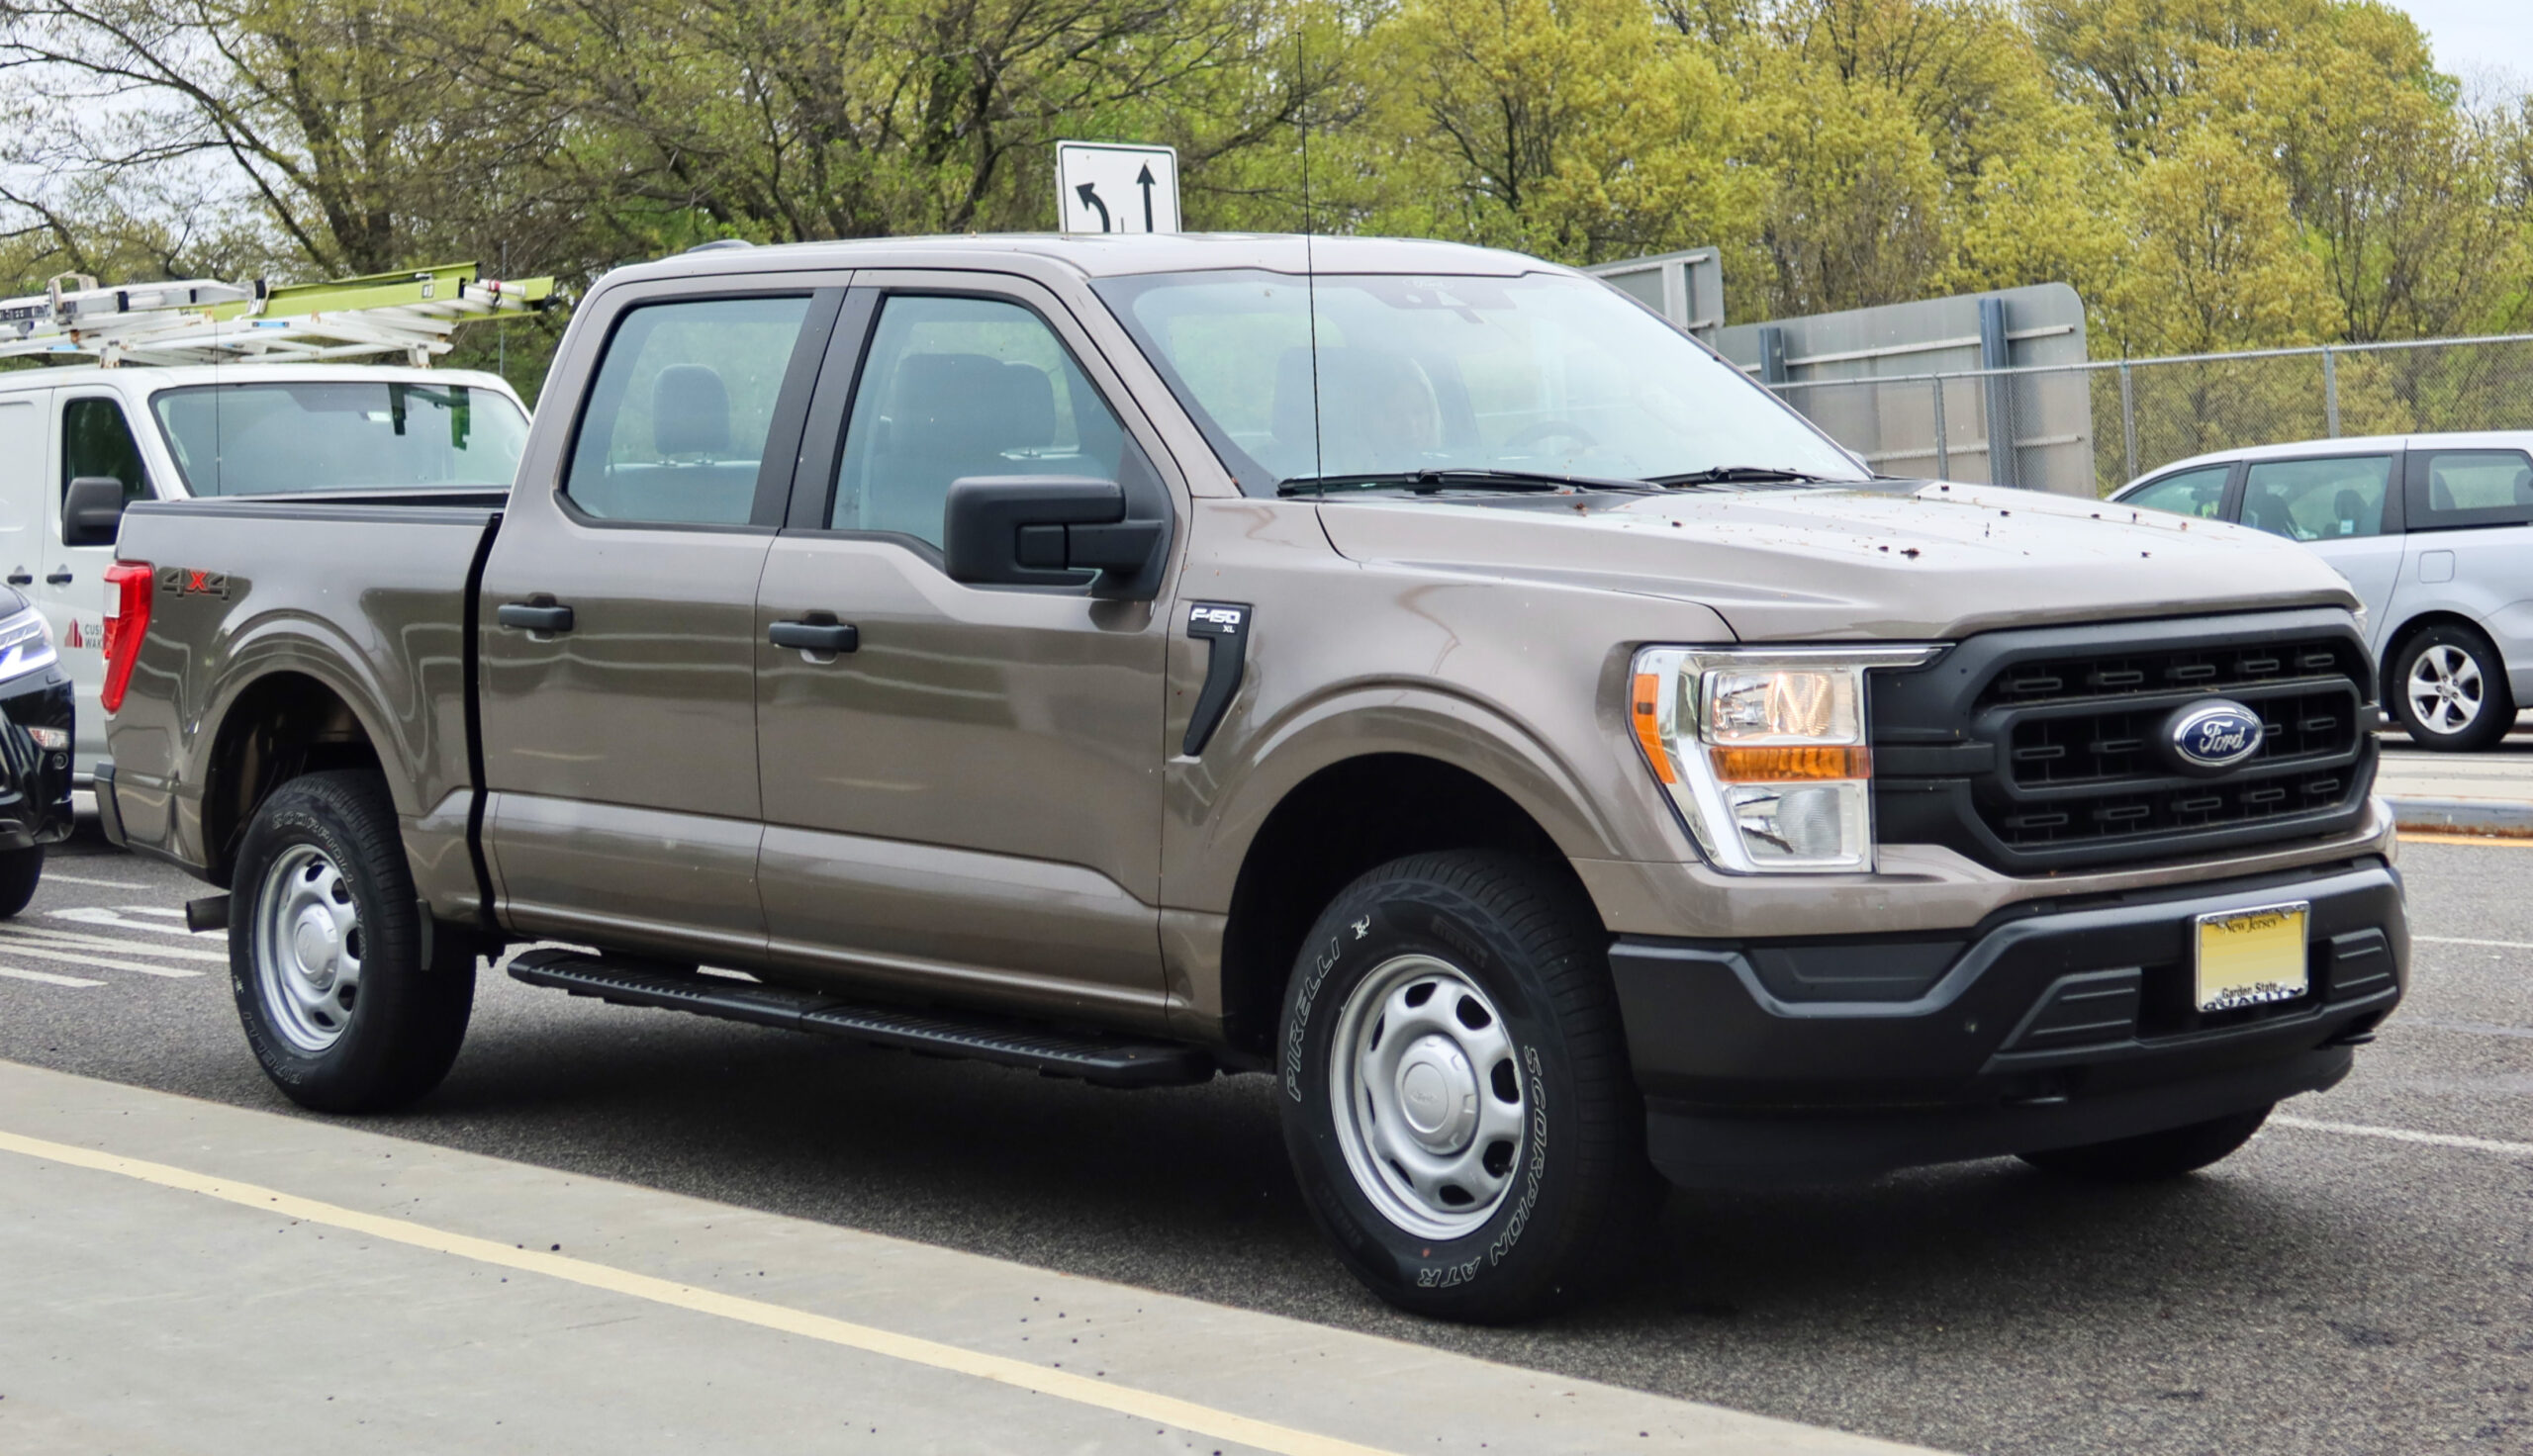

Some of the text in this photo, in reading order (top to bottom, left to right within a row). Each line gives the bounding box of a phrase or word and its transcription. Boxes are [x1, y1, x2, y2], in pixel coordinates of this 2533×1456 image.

[1190, 607, 1242, 625] F-150
[1222, 624, 1235, 633] XL
[2200, 720, 2246, 755] Ford
[2222, 980, 2279, 999] Garden State
[1286, 937, 1340, 1102] PIRELLI
[1418, 1045, 1548, 1289] SCORPION ATR
